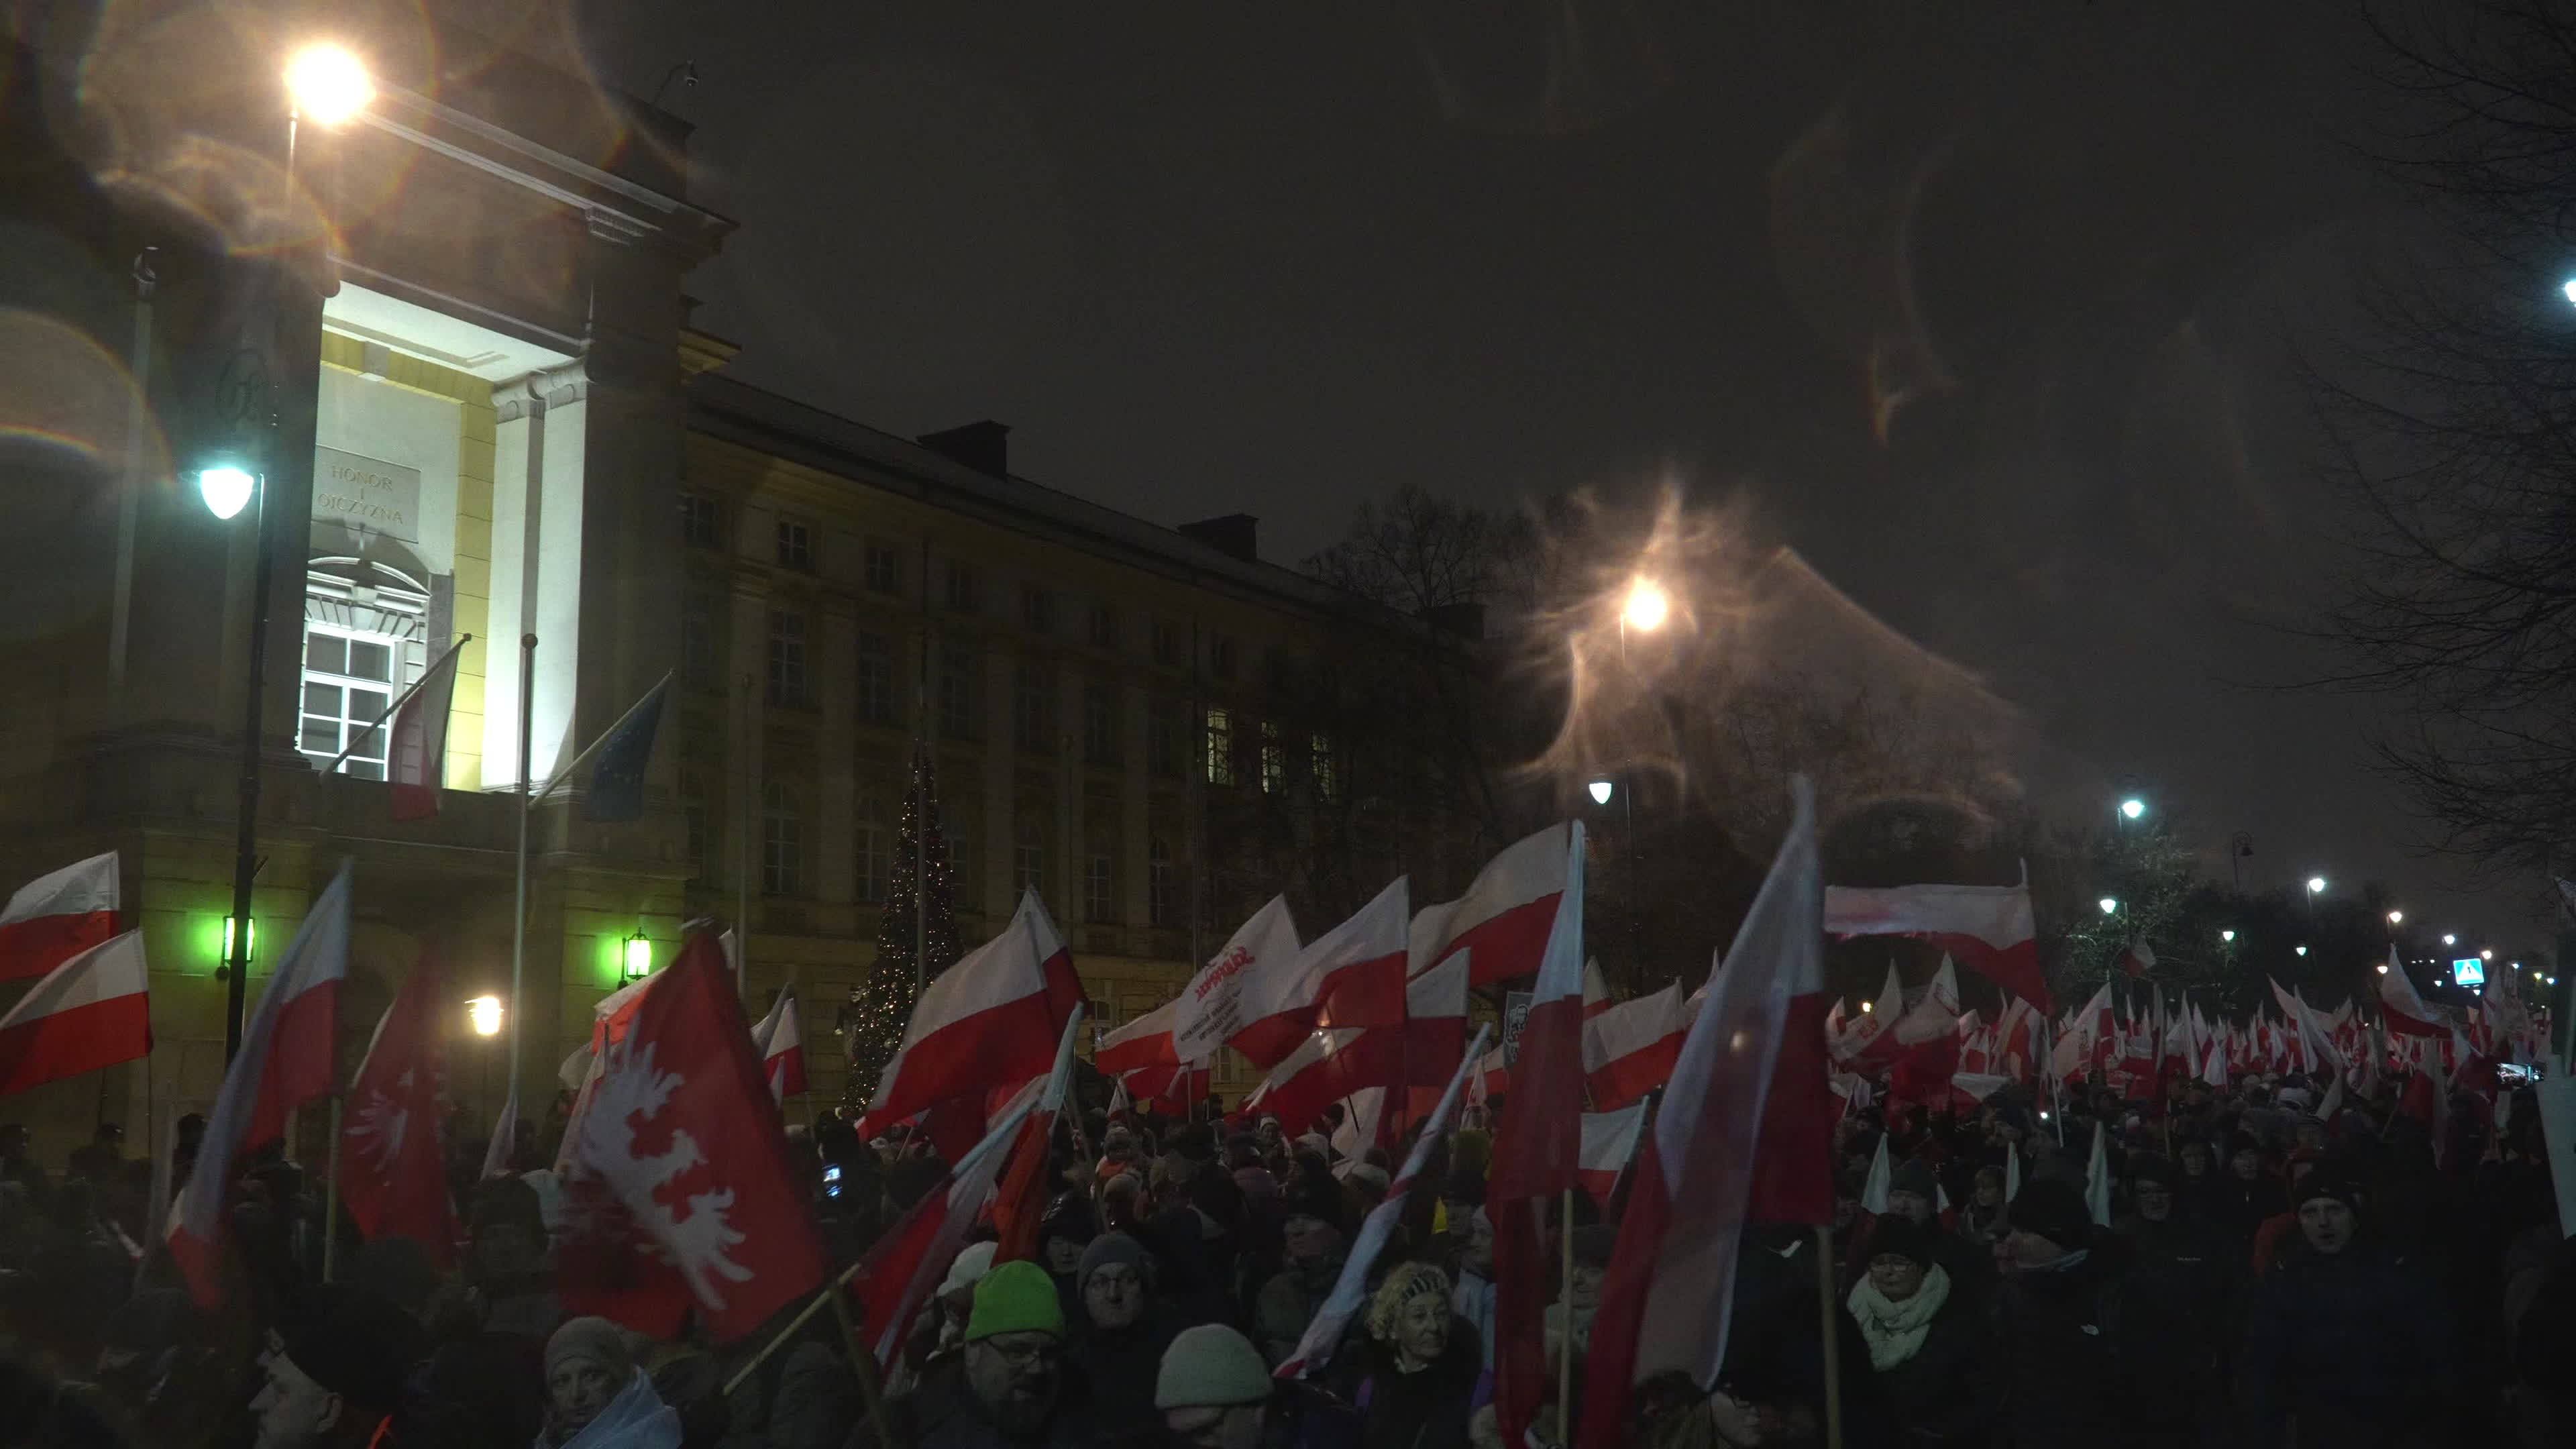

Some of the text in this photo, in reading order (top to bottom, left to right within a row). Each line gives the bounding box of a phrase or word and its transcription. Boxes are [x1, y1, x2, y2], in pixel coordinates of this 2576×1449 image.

[332, 466, 392, 492] HONOR
[360, 488, 365, 500] I
[317, 493, 403, 525] OJCZYZNA
